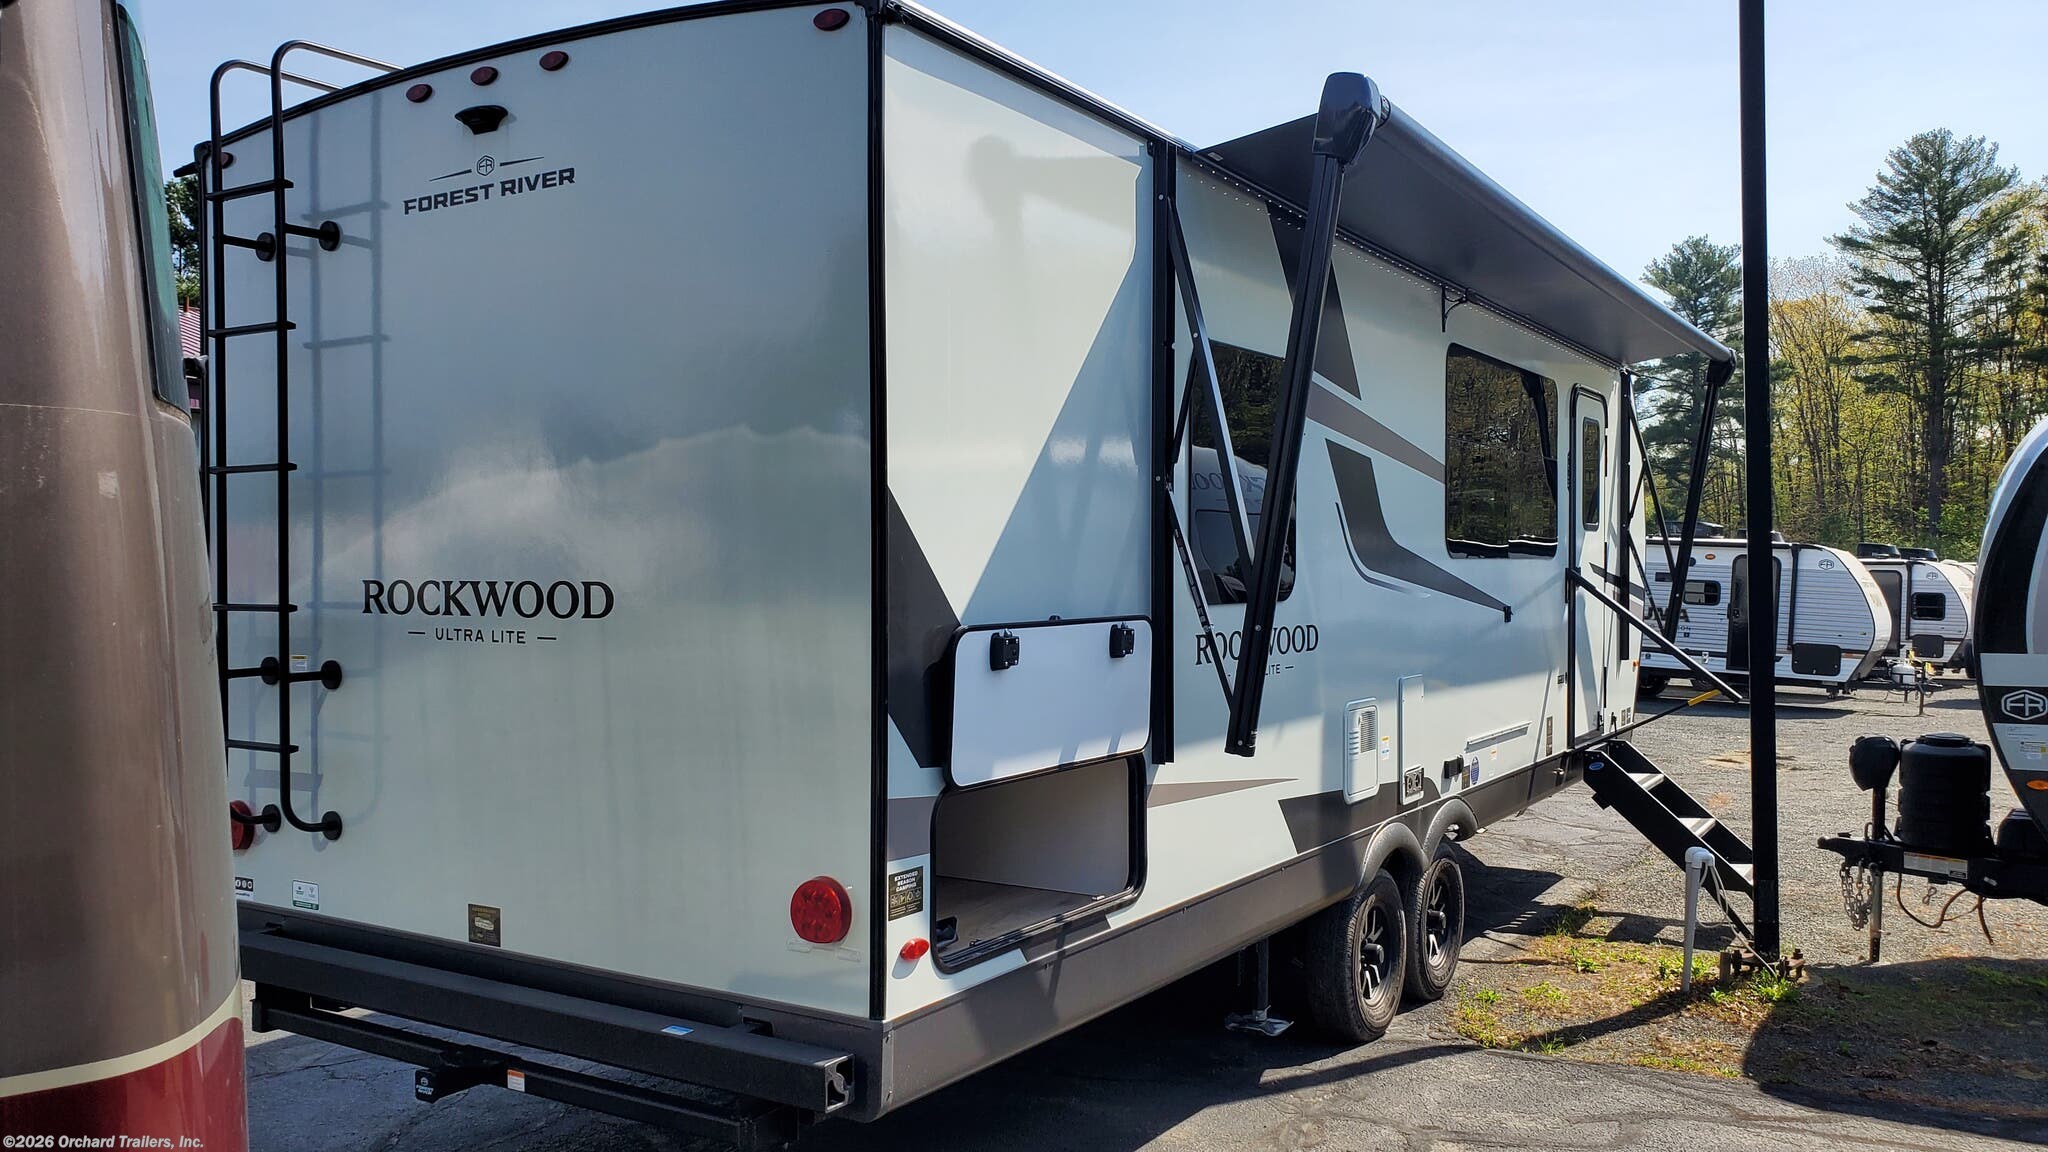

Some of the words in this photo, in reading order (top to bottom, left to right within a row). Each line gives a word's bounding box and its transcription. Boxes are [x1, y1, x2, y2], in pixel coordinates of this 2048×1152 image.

[403, 183, 494, 215] FOREST
[500, 167, 575, 196] RIVER
[362, 579, 614, 619] ROCKWOOD
[435, 627, 484, 643] ULTRA
[491, 630, 526, 644] LITE
